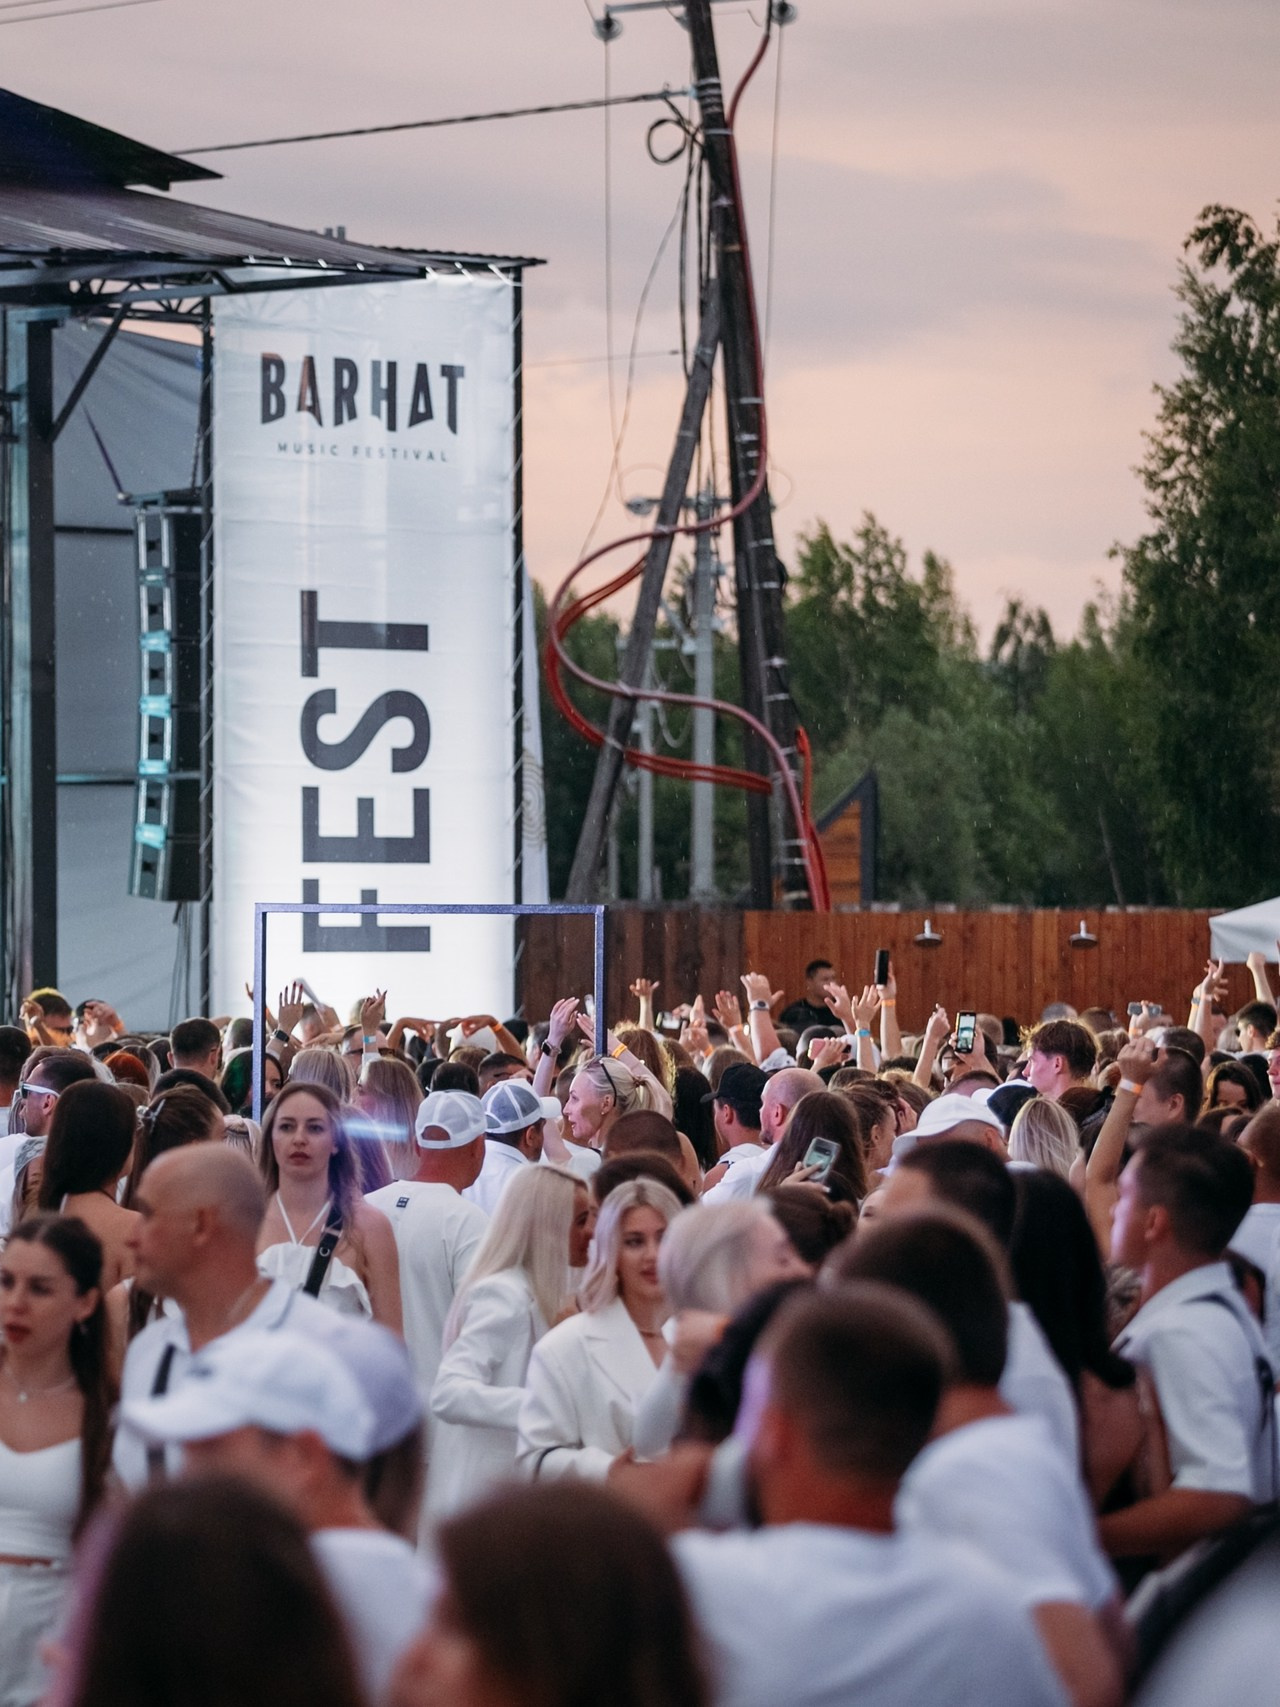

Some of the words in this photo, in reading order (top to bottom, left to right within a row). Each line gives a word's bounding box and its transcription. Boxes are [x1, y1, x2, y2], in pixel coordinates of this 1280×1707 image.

[261, 352, 465, 436] BARHAT
[277, 442, 339, 457] MUSIC
[352, 445, 448, 463] FESTIVAL
[300, 589, 431, 953] FEST
